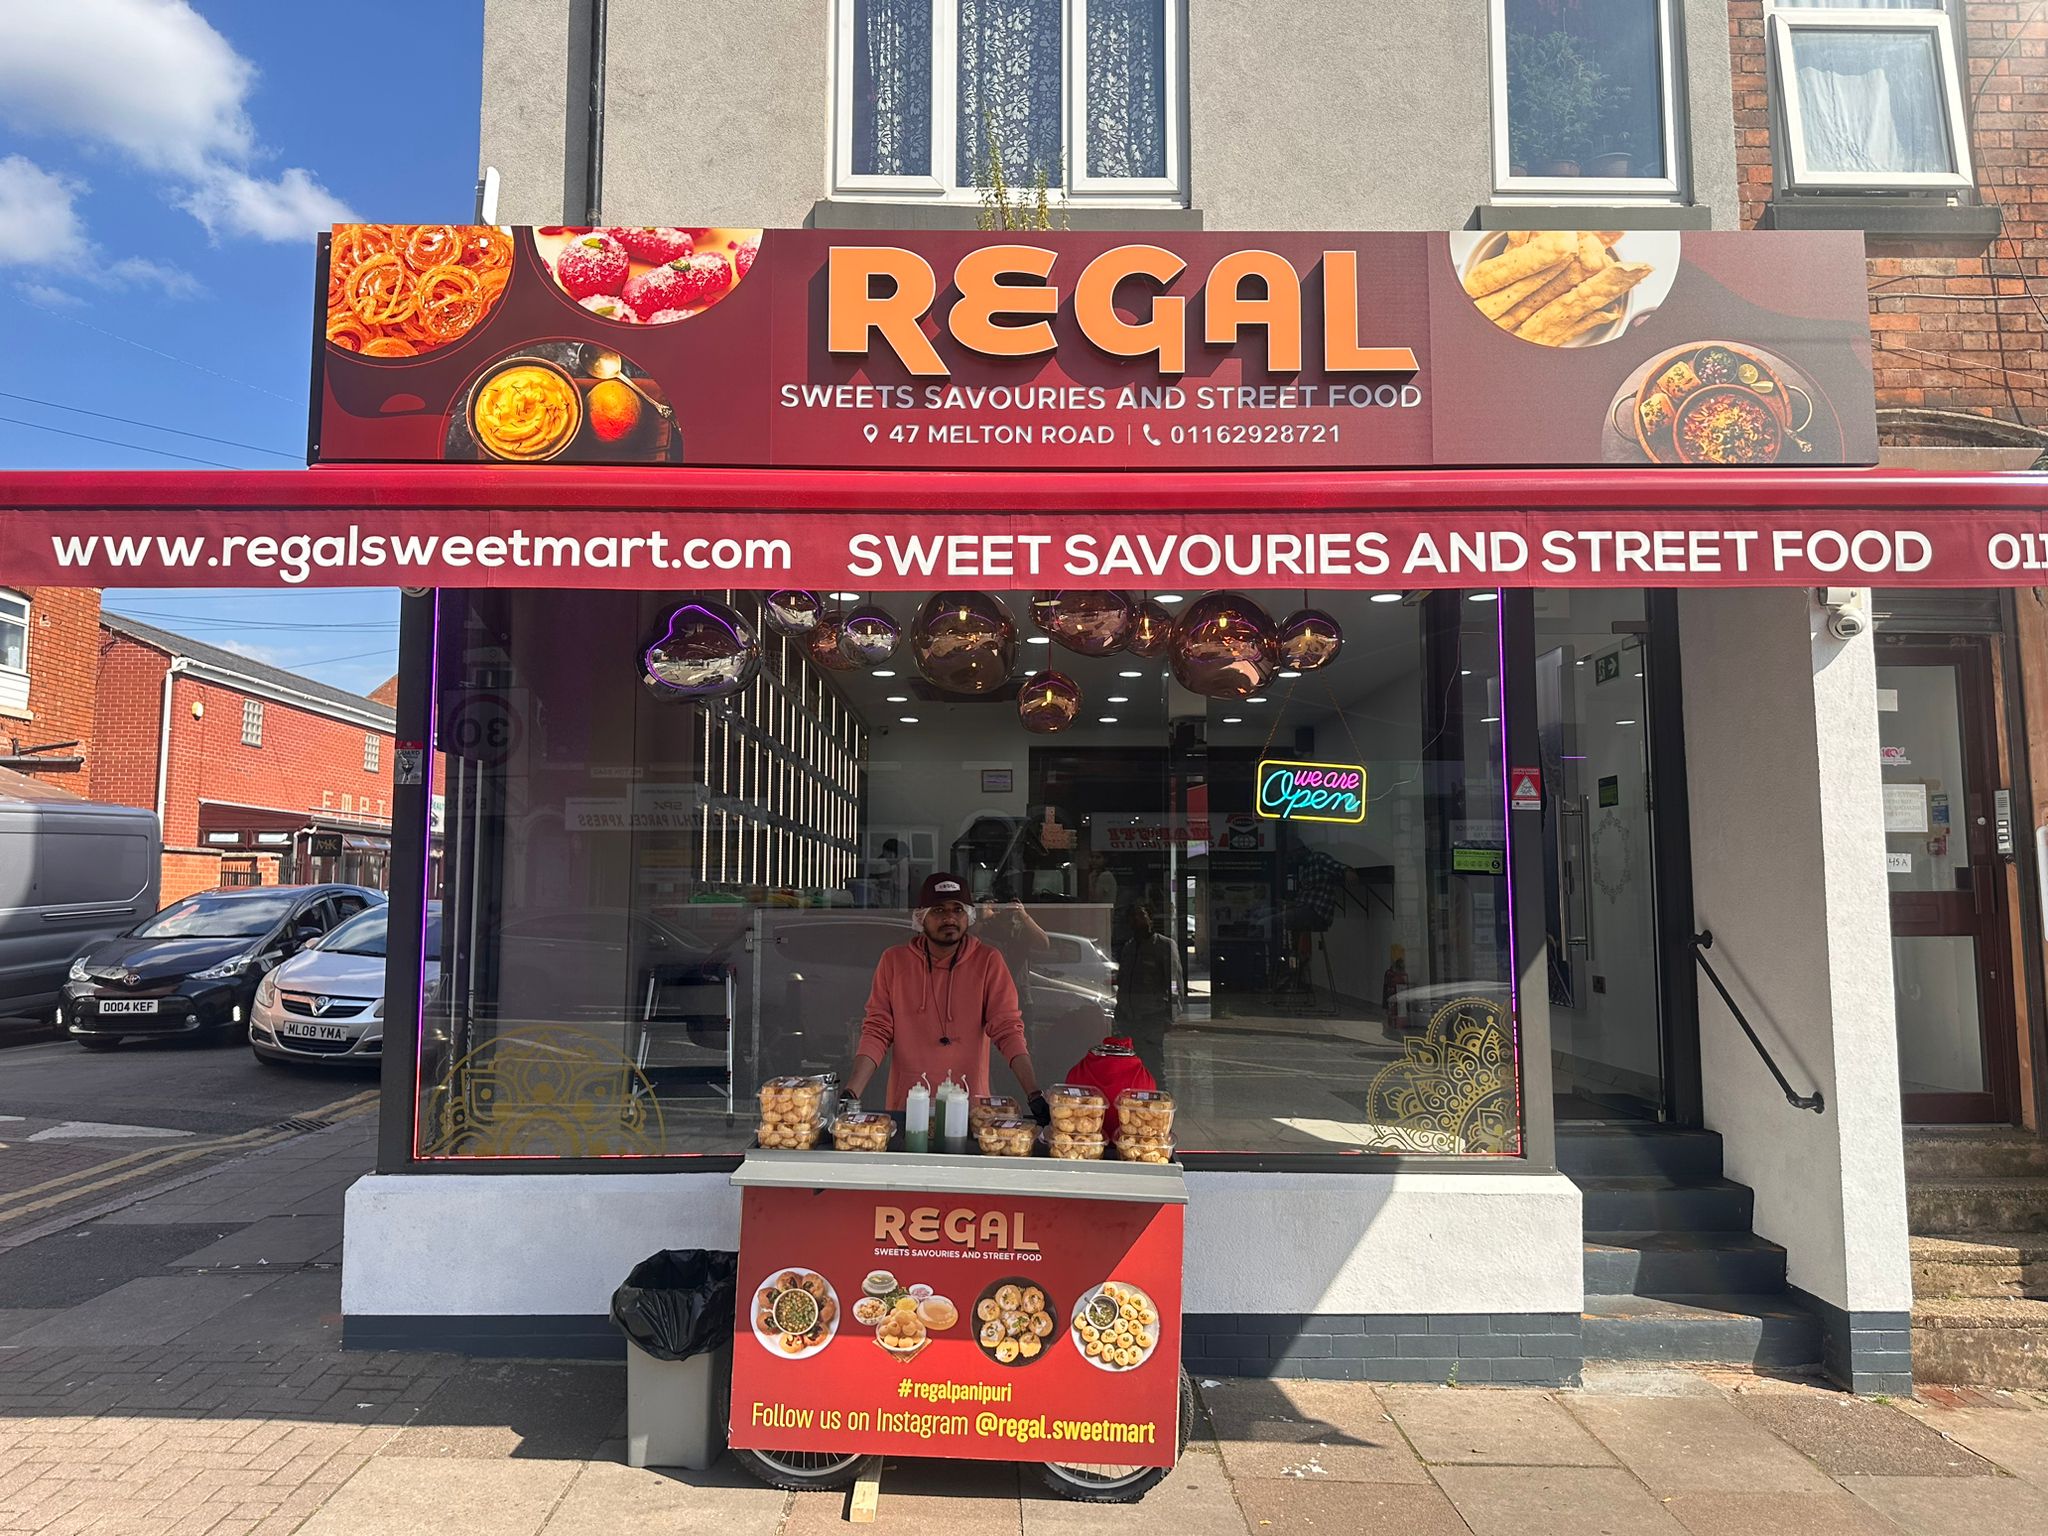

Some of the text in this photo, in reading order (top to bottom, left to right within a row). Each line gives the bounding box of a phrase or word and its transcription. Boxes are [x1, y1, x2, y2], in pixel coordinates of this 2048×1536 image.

[827, 243, 1420, 377] REGAL
[780, 382, 1423, 411] SWEETS SAVOURIES AND STREET FOOD
[888, 423, 1116, 445] 47 MELTON ROAD
[1169, 423, 1342, 446] 01162928721
[51, 525, 793, 585] www.regalsweetmart.com
[847, 529, 1933, 577] SWEET SAVOURIES AND STREET FOOD
[1293, 769, 1361, 790] we are
[1261, 769, 1361, 819] Open
[132, 1001, 154, 1012] KEF
[287, 1023, 343, 1040] ML08 YMA
[874, 1205, 1041, 1252] REGAL
[874, 1247, 1043, 1262] SWEETS SAVOURIES AND STREET FOOD
[897, 1377, 1013, 1404] #regalpanipuri
[751, 1402, 1156, 1444] Follow us on Instagram @regal.sweetmart
